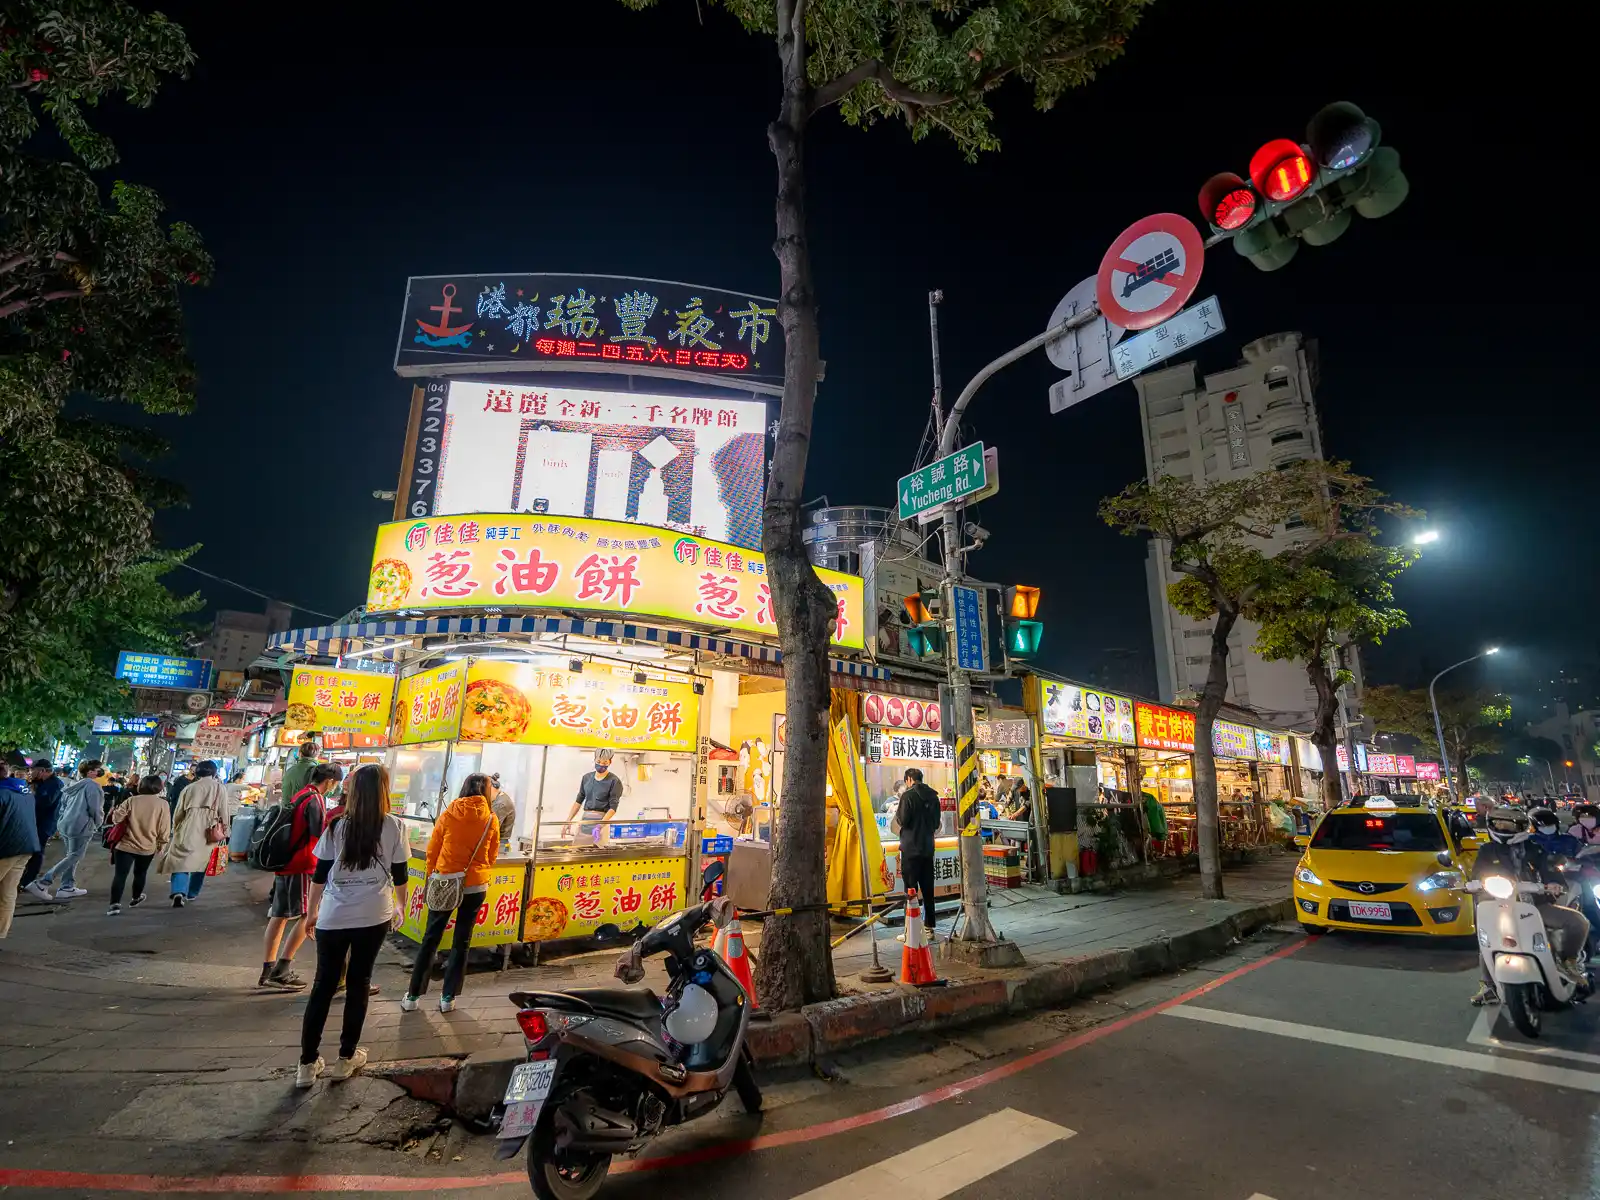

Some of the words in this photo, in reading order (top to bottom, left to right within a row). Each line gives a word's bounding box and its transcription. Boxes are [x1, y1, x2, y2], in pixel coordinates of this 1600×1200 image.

[1120, 321, 1217, 373] 禁止進入
[427, 382, 448, 394] (04)
[910, 453, 970, 494] 裕誠路
[911, 484, 954, 511] Yucheng
[955, 474, 972, 493] Rd.
[408, 521, 480, 550] 何佳佳
[486, 526, 522, 540] 純手工
[676, 540, 744, 573] 何佳佳
[1138, 706, 1195, 743] 蒙古烤肉
[869, 727, 882, 764] 瑞豐
[559, 874, 601, 891] 何佳佳
